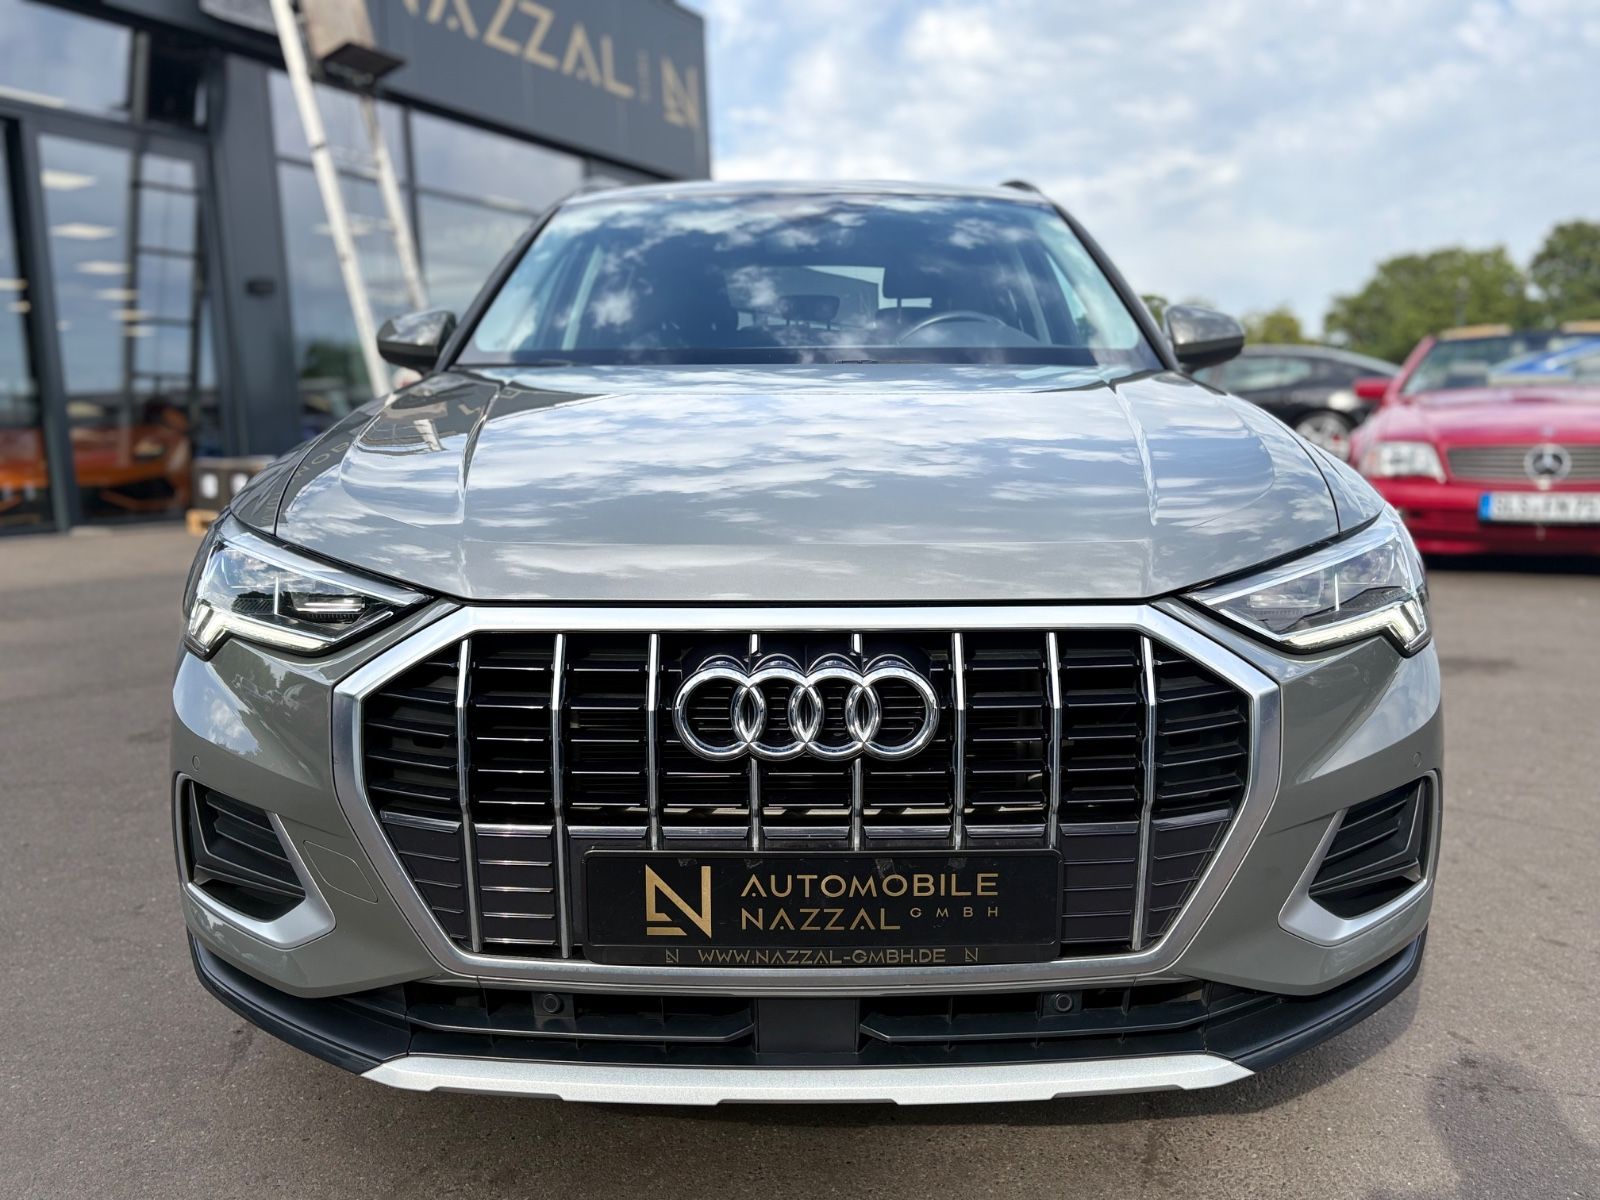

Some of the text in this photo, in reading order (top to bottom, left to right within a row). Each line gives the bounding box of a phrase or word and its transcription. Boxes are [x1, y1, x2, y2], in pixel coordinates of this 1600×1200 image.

[401, 0, 635, 98] AZZAL
[740, 873, 999, 898] AUTOMOBILE
[741, 907, 901, 931] NAZZAL
[698, 948, 946, 964] WWW.NAZZAL-GMBH.DE
